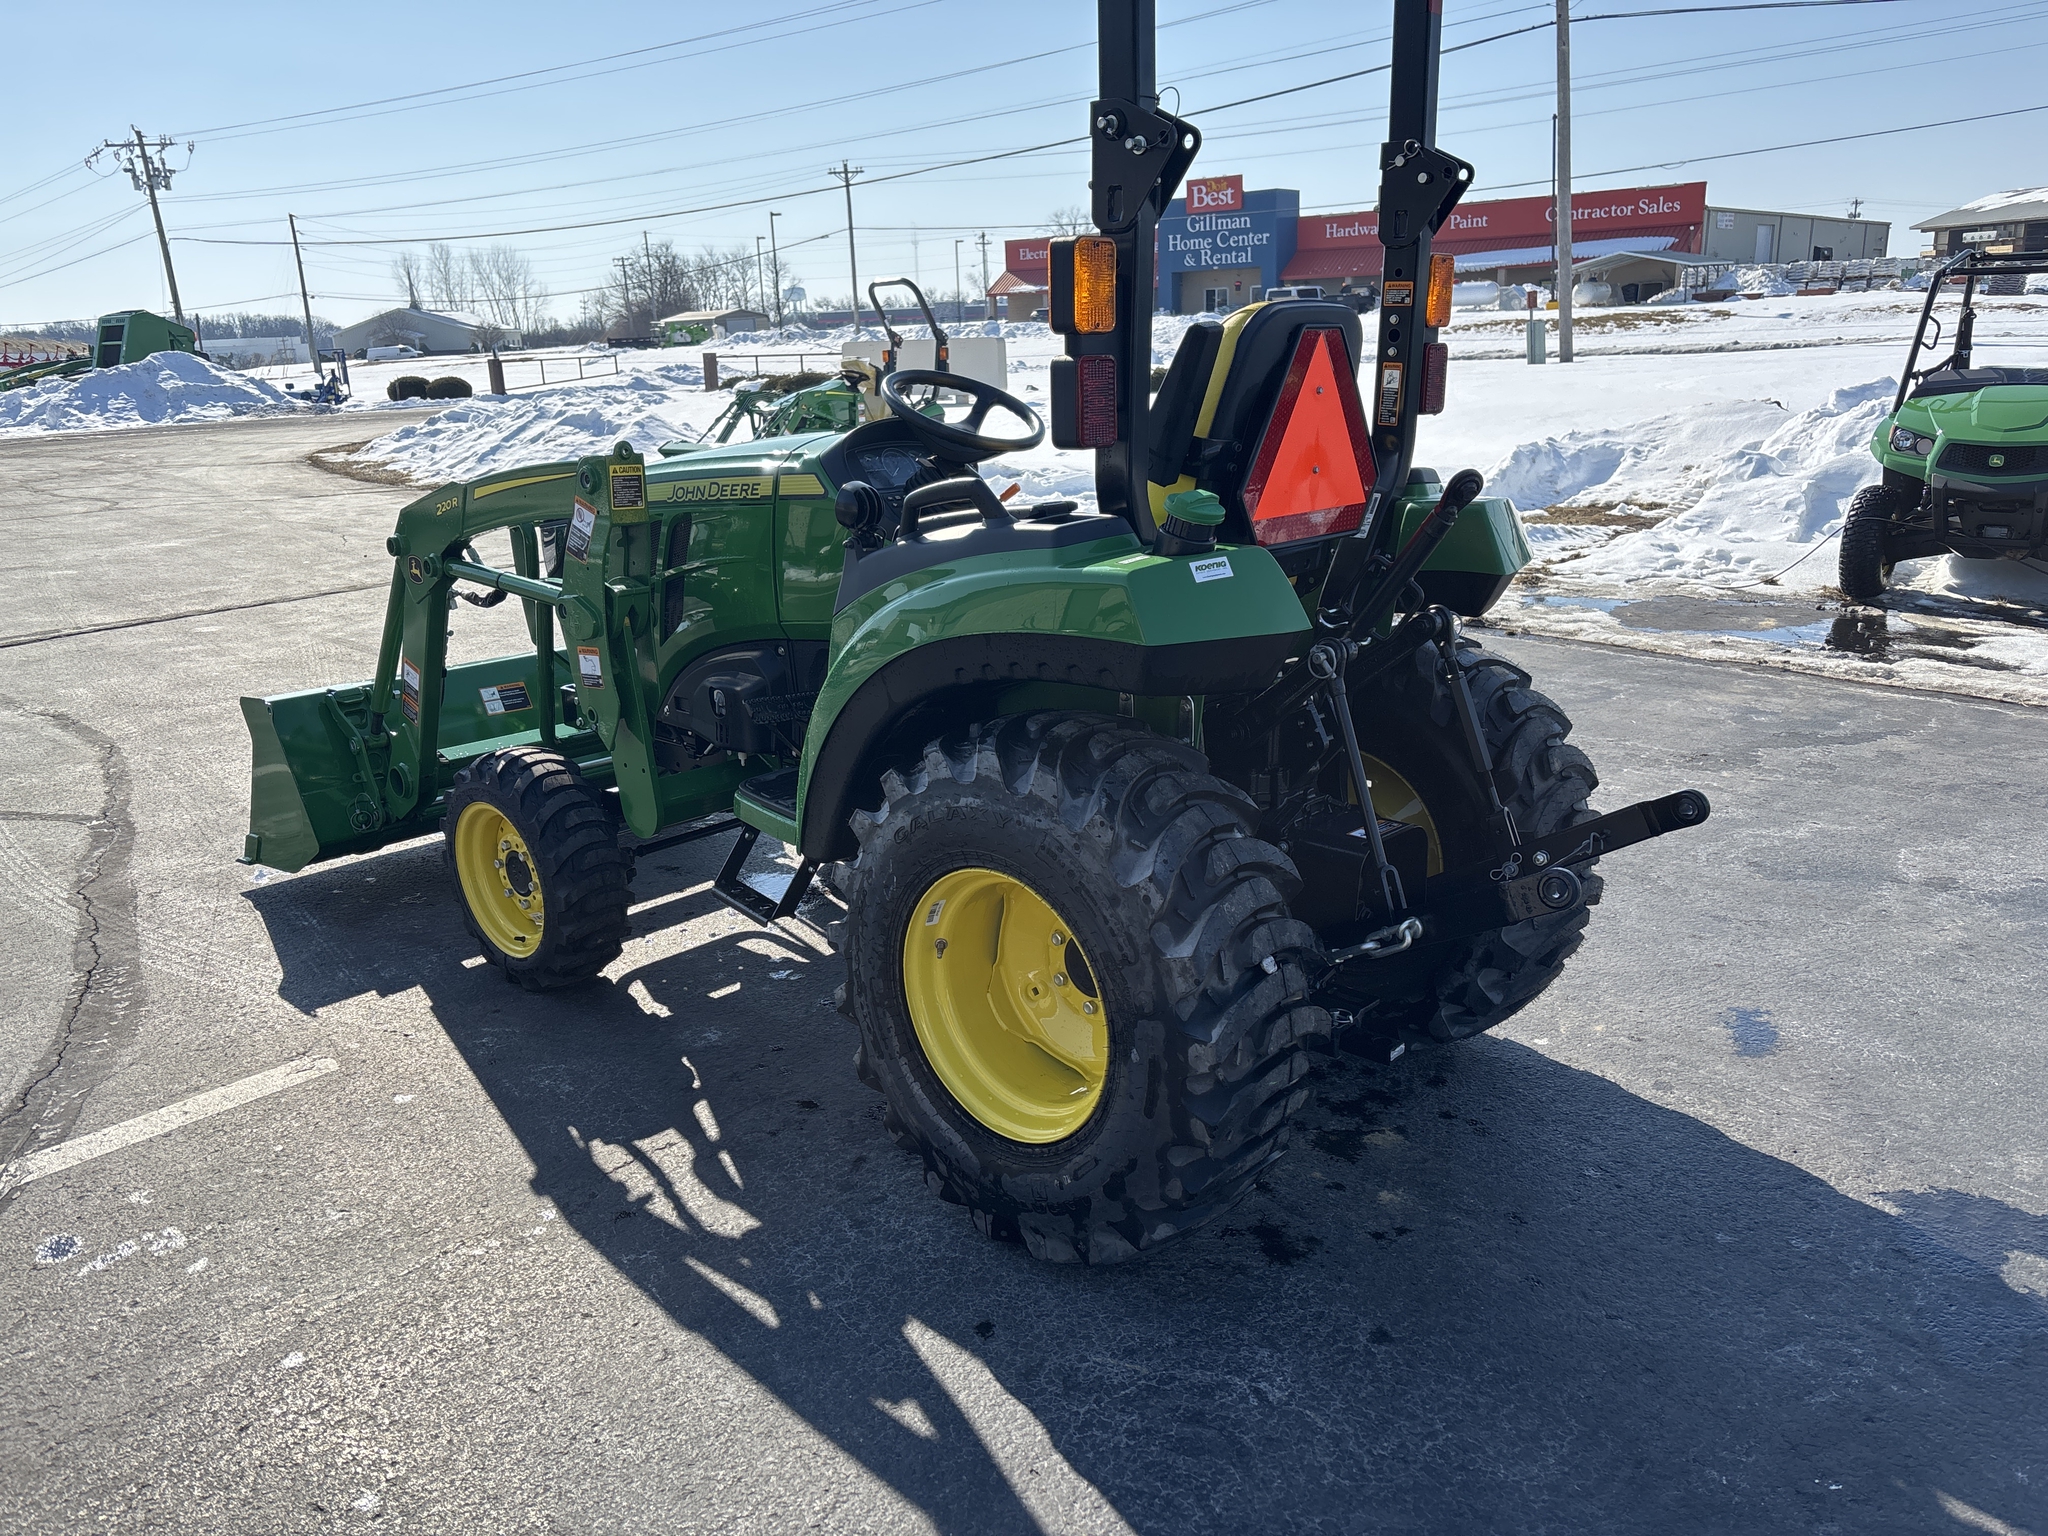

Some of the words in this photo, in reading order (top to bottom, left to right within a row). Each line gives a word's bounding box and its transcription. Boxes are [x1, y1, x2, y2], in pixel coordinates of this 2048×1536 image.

[1191, 185, 1235, 208] Best
[1545, 204, 1635, 222] Cntractor
[1638, 196, 1681, 215] Sales
[1186, 214, 1251, 233] Gillman
[1325, 222, 1379, 239] Hardwa
[1450, 214, 1488, 230] Paint
[1168, 234, 1212, 252] Home
[1216, 231, 1270, 248] Center
[1019, 248, 1048, 260] Electr
[1183, 253, 1196, 267] &
[1200, 247, 1253, 266] Rental
[618, 466, 641, 474] CAUTION
[667, 484, 706, 501] JOHN
[708, 482, 761, 498] DEERE
[893, 804, 1013, 845] GALAXY
